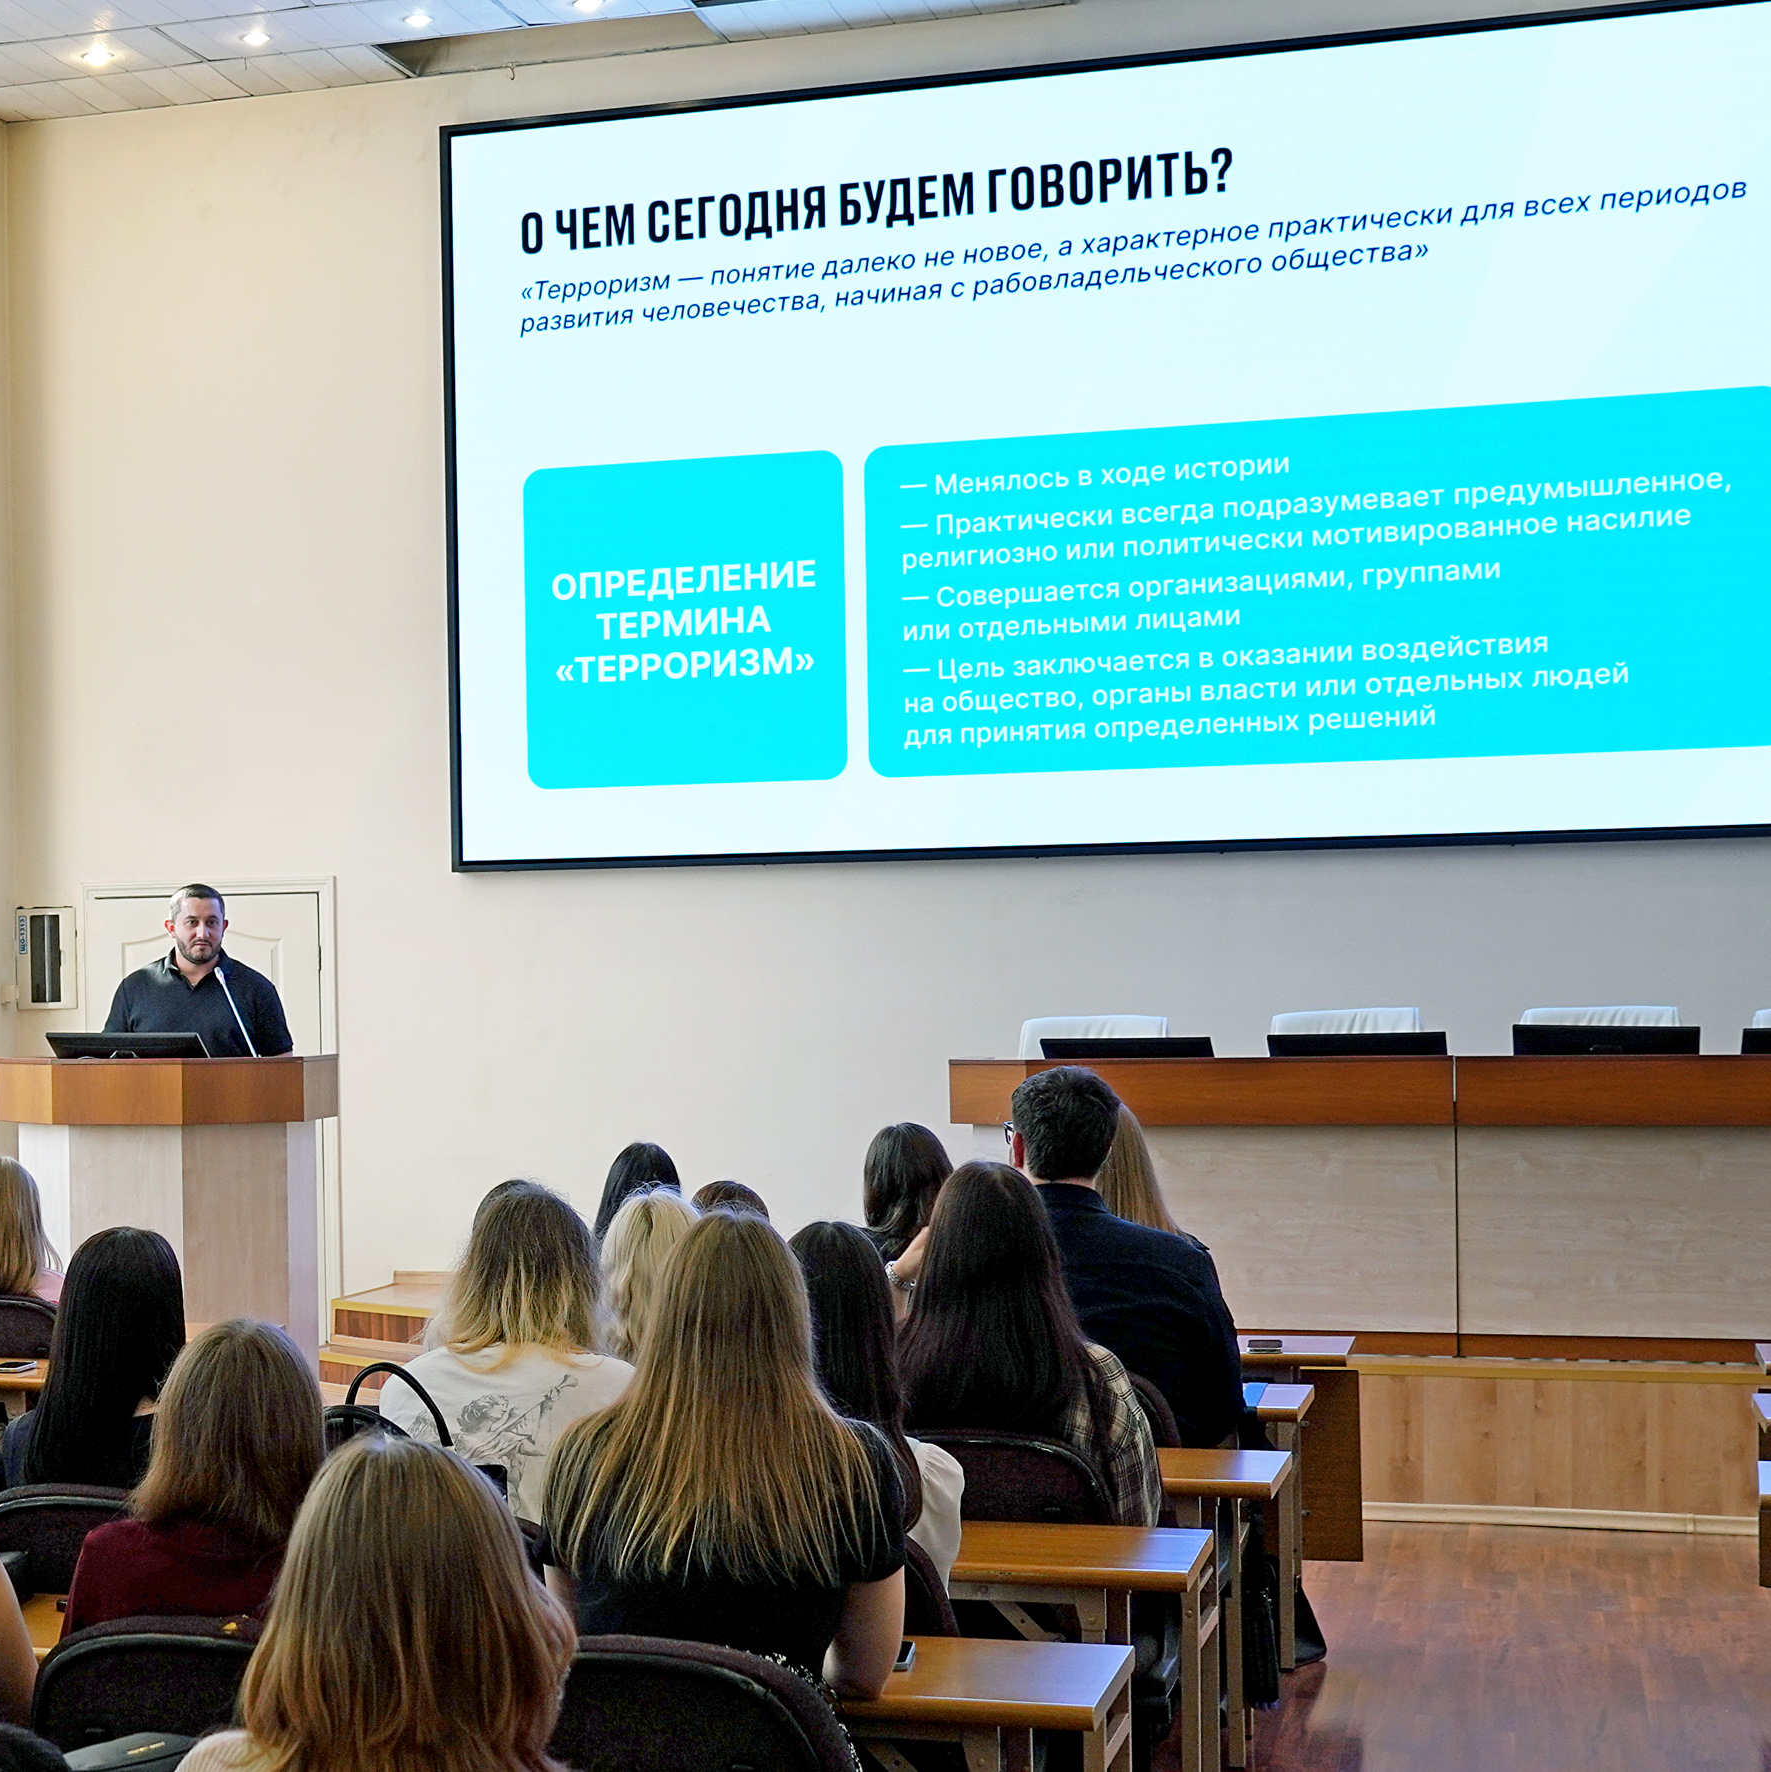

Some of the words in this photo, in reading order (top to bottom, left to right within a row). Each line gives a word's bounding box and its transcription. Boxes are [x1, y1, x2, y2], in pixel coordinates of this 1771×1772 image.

[521, 211, 544, 255] О
[555, 202, 635, 251] ЧЕМ
[647, 185, 826, 244] СЕГОДНЯ
[839, 171, 974, 229] БУДЕМ
[988, 147, 1233, 213] ГОВОРИТЬ?
[521, 274, 671, 303] «Терроризм
[711, 262, 815, 286] понятие
[821, 253, 916, 281] далеко
[924, 250, 955, 268] не
[963, 242, 1048, 264] новое,
[1058, 239, 1073, 257] а
[1081, 223, 1259, 257] характерное
[1268, 207, 1453, 243] практически
[1459, 201, 1515, 227] для
[1524, 194, 1591, 217] всех
[1600, 181, 1747, 213] периодов
[520, 308, 634, 338] развития
[642, 293, 825, 322] человечества,
[835, 283, 943, 307] начиная
[950, 281, 965, 298] с
[972, 256, 1262, 301] рабовладельческого
[1271, 244, 1429, 272] общества»
[935, 471, 1070, 496] Менялось
[1078, 469, 1093, 486] в
[1101, 464, 1166, 487] ходе
[1174, 456, 1290, 482] истории
[936, 508, 1113, 540] Практически
[1121, 502, 1214, 525] всегда
[1223, 488, 1445, 521] подразумевает
[1454, 471, 1731, 510] предумышленное,
[902, 544, 1058, 575] религиозно
[1066, 541, 1114, 560] или
[1123, 530, 1303, 557] политически
[1312, 516, 1558, 547] мотивированное
[1567, 508, 1691, 532] насилие
[551, 559, 816, 602] ОПРЕДЕЛЕНИЕ
[936, 582, 1120, 610] Совершается
[1128, 569, 1353, 602] организациями,
[1362, 561, 1501, 591] группами
[595, 605, 772, 641] ТЕРМИНА
[903, 623, 950, 642] или
[958, 614, 1127, 642] отдельными
[1135, 608, 1241, 633] лицами
[555, 646, 815, 684] «ТЕРРОРИЗМ»
[938, 658, 1005, 684] Цель
[1013, 652, 1190, 677] заключается
[1199, 651, 1214, 668] в
[1222, 645, 1353, 667] оказании
[1362, 635, 1548, 663] воздействия
[904, 696, 934, 714] на
[942, 689, 1084, 714] общество,
[1092, 685, 1191, 711] органы
[1200, 680, 1296, 702] власти
[1306, 678, 1356, 697] или
[1365, 671, 1523, 698] отдельных
[1531, 661, 1629, 690] людей
[903, 728, 952, 750] для
[960, 722, 1086, 749] принятия
[1094, 714, 1299, 743] определенных
[1308, 703, 1436, 736] решений
